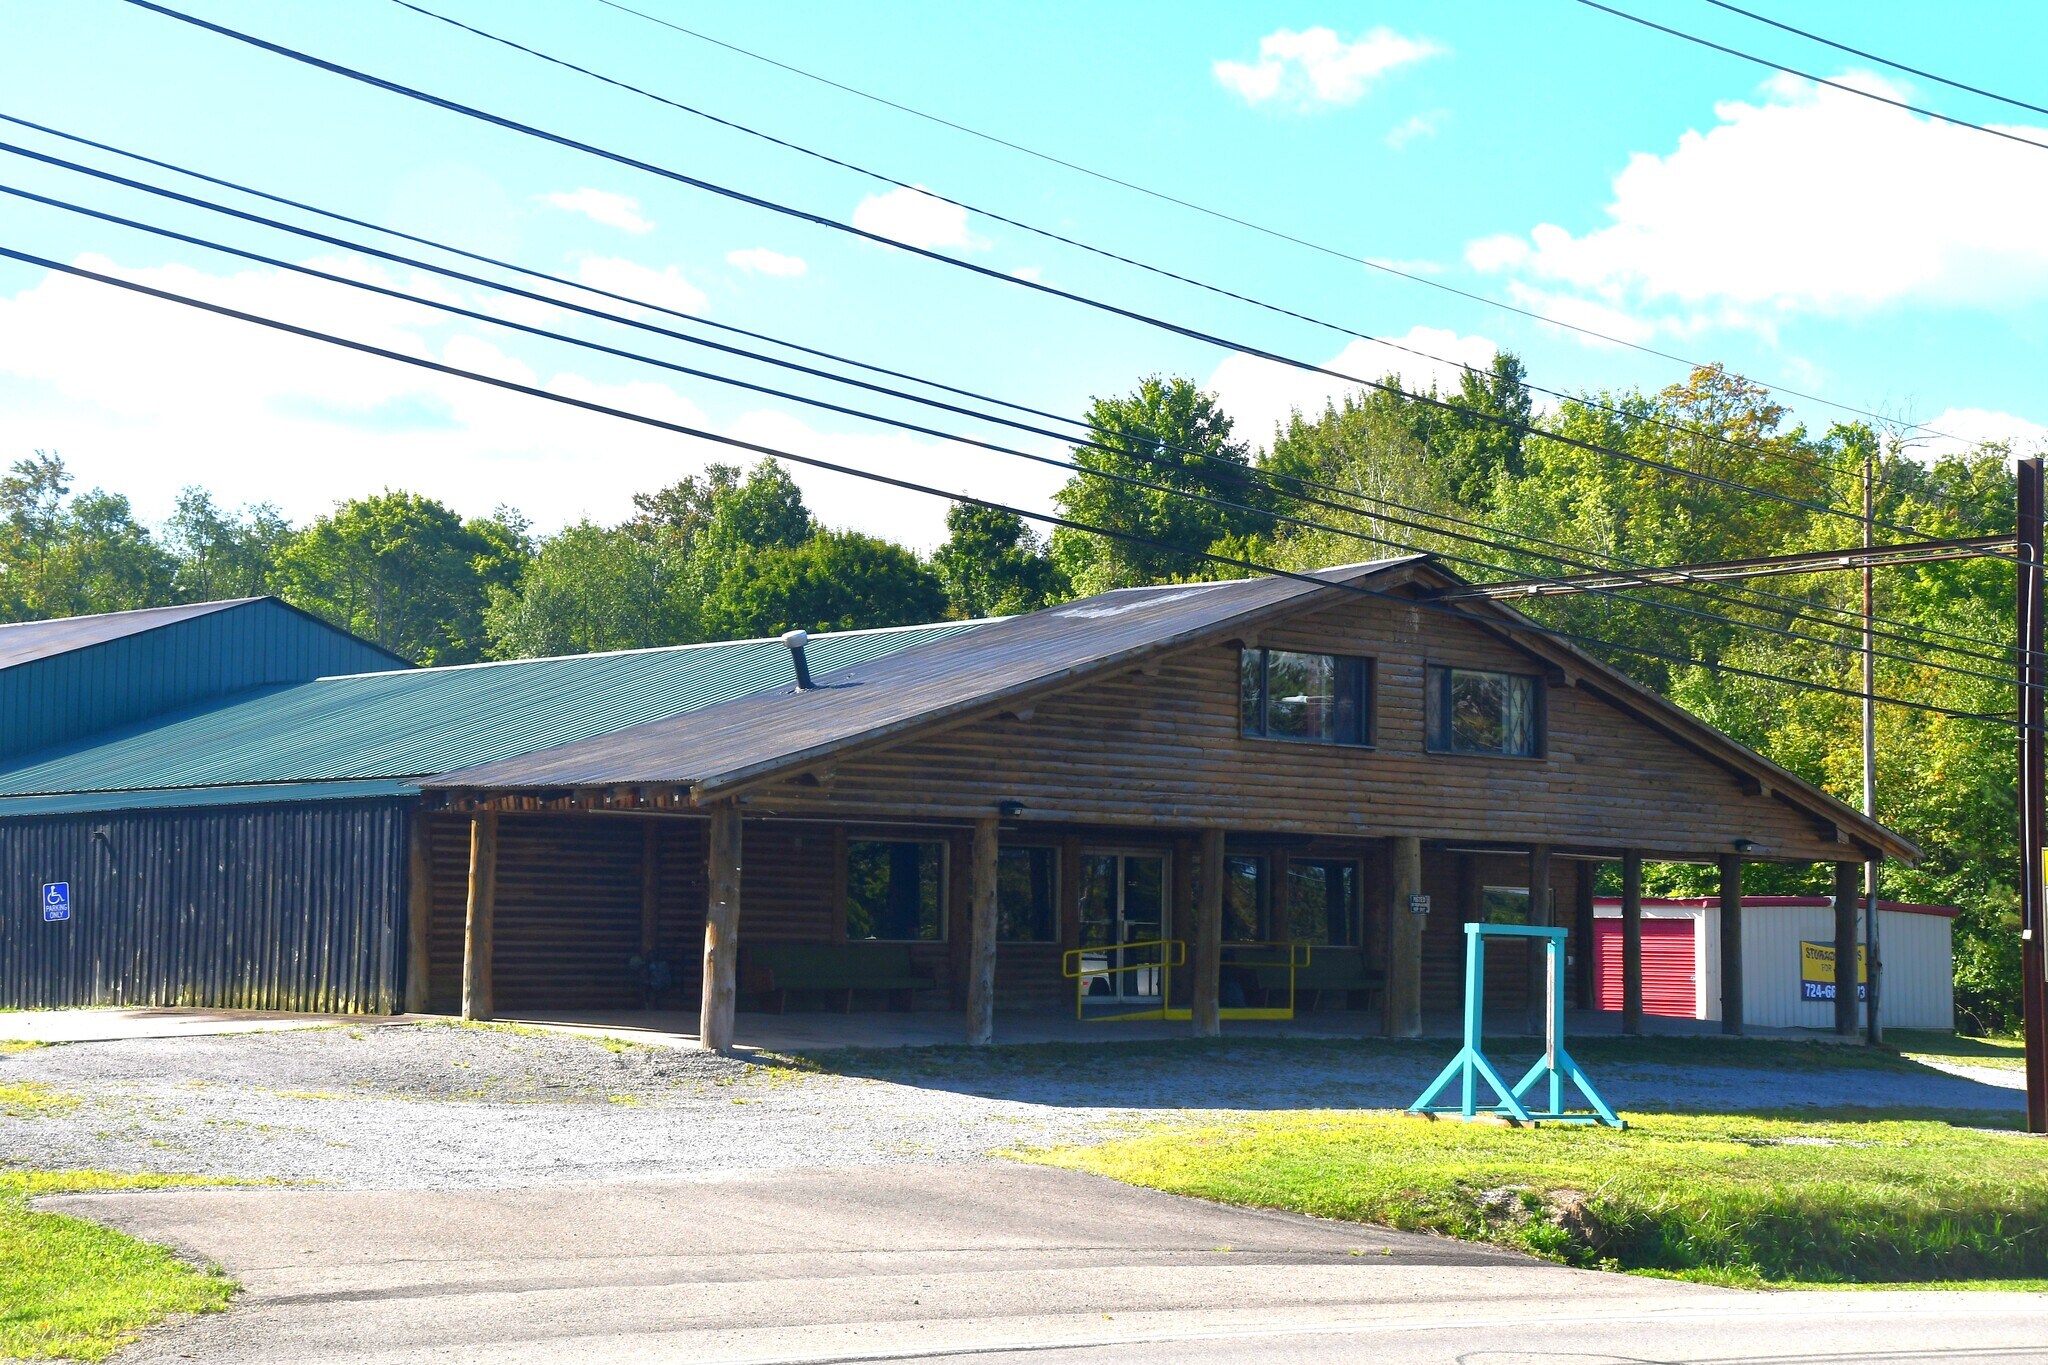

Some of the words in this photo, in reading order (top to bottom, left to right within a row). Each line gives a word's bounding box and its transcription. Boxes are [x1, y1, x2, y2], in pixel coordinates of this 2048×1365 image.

[46, 904, 68, 912] PARKING
[50, 911, 64, 919] ONLY
[1805, 947, 1835, 961] STORAG
